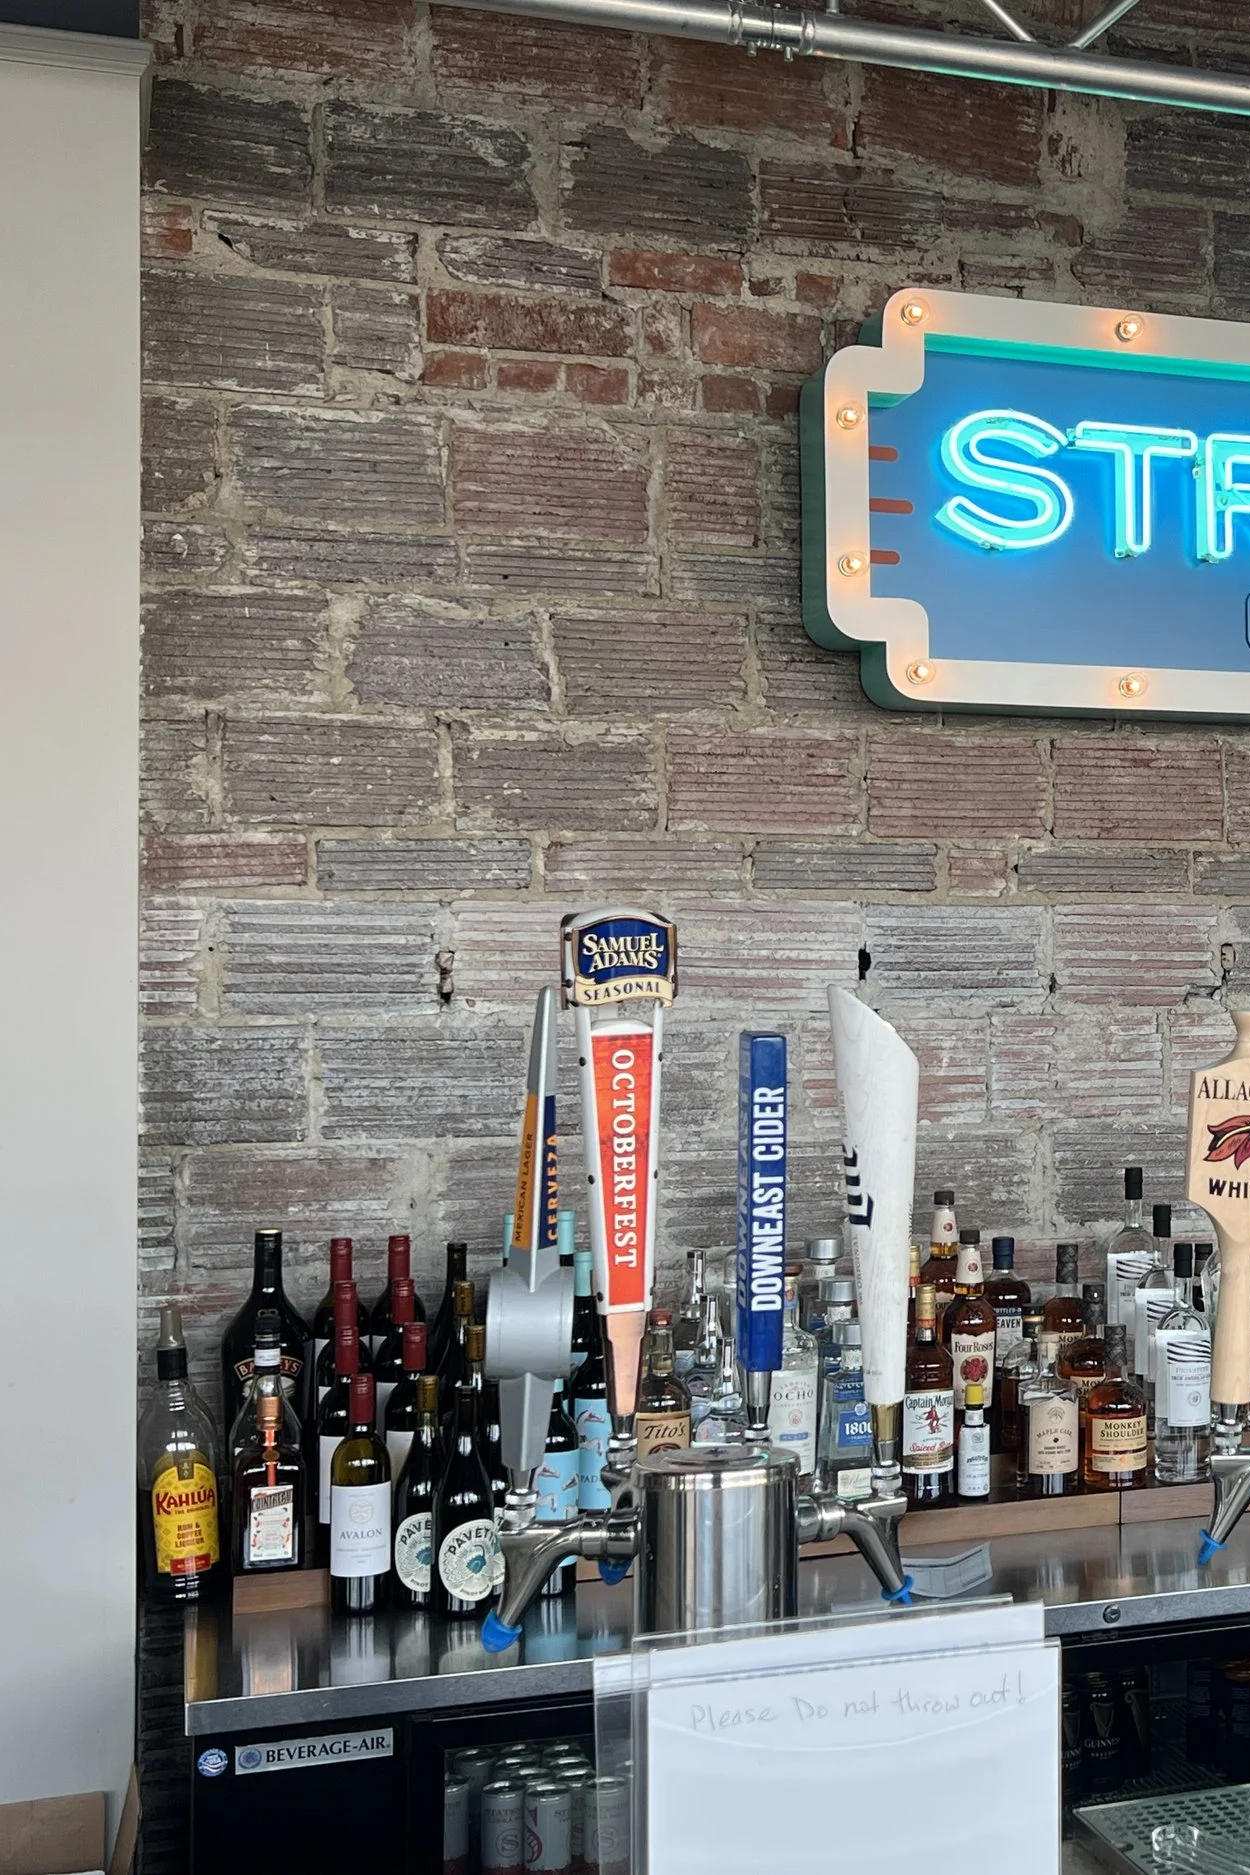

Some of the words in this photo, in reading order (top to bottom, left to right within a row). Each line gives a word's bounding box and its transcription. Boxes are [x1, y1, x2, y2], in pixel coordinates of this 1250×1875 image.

[582, 932, 664, 956] SAMUEL
[588, 950, 659, 973] ADAMS
[583, 980, 662, 1001] SEASONAL
[752, 1085, 785, 1162] CIDER
[611, 1049, 637, 1268] OCTOBERFEST
[515, 1180, 527, 1242] MEXICAN
[522, 1132, 534, 1176] LAGER
[751, 1172, 785, 1312] DOWNEAST
[239, 1359, 300, 1376] BAYS
[773, 1388, 815, 1402] OCHO
[905, 1395, 933, 1411] Captain
[643, 1422, 686, 1440] Tito's
[1104, 1420, 1142, 1431] MONKEY
[155, 1484, 216, 1516] KAHLÚA
[339, 1528, 384, 1540] AVALON
[690, 1703, 776, 1732] Please
[790, 1695, 829, 1722] Do
[843, 1690, 880, 1717] not
[891, 1686, 960, 1715] throw
[969, 1669, 1027, 1708] out!
[266, 1736, 388, 1764] BEVERAGE-AIR
[1083, 1736, 1121, 1750] GUINNESS
